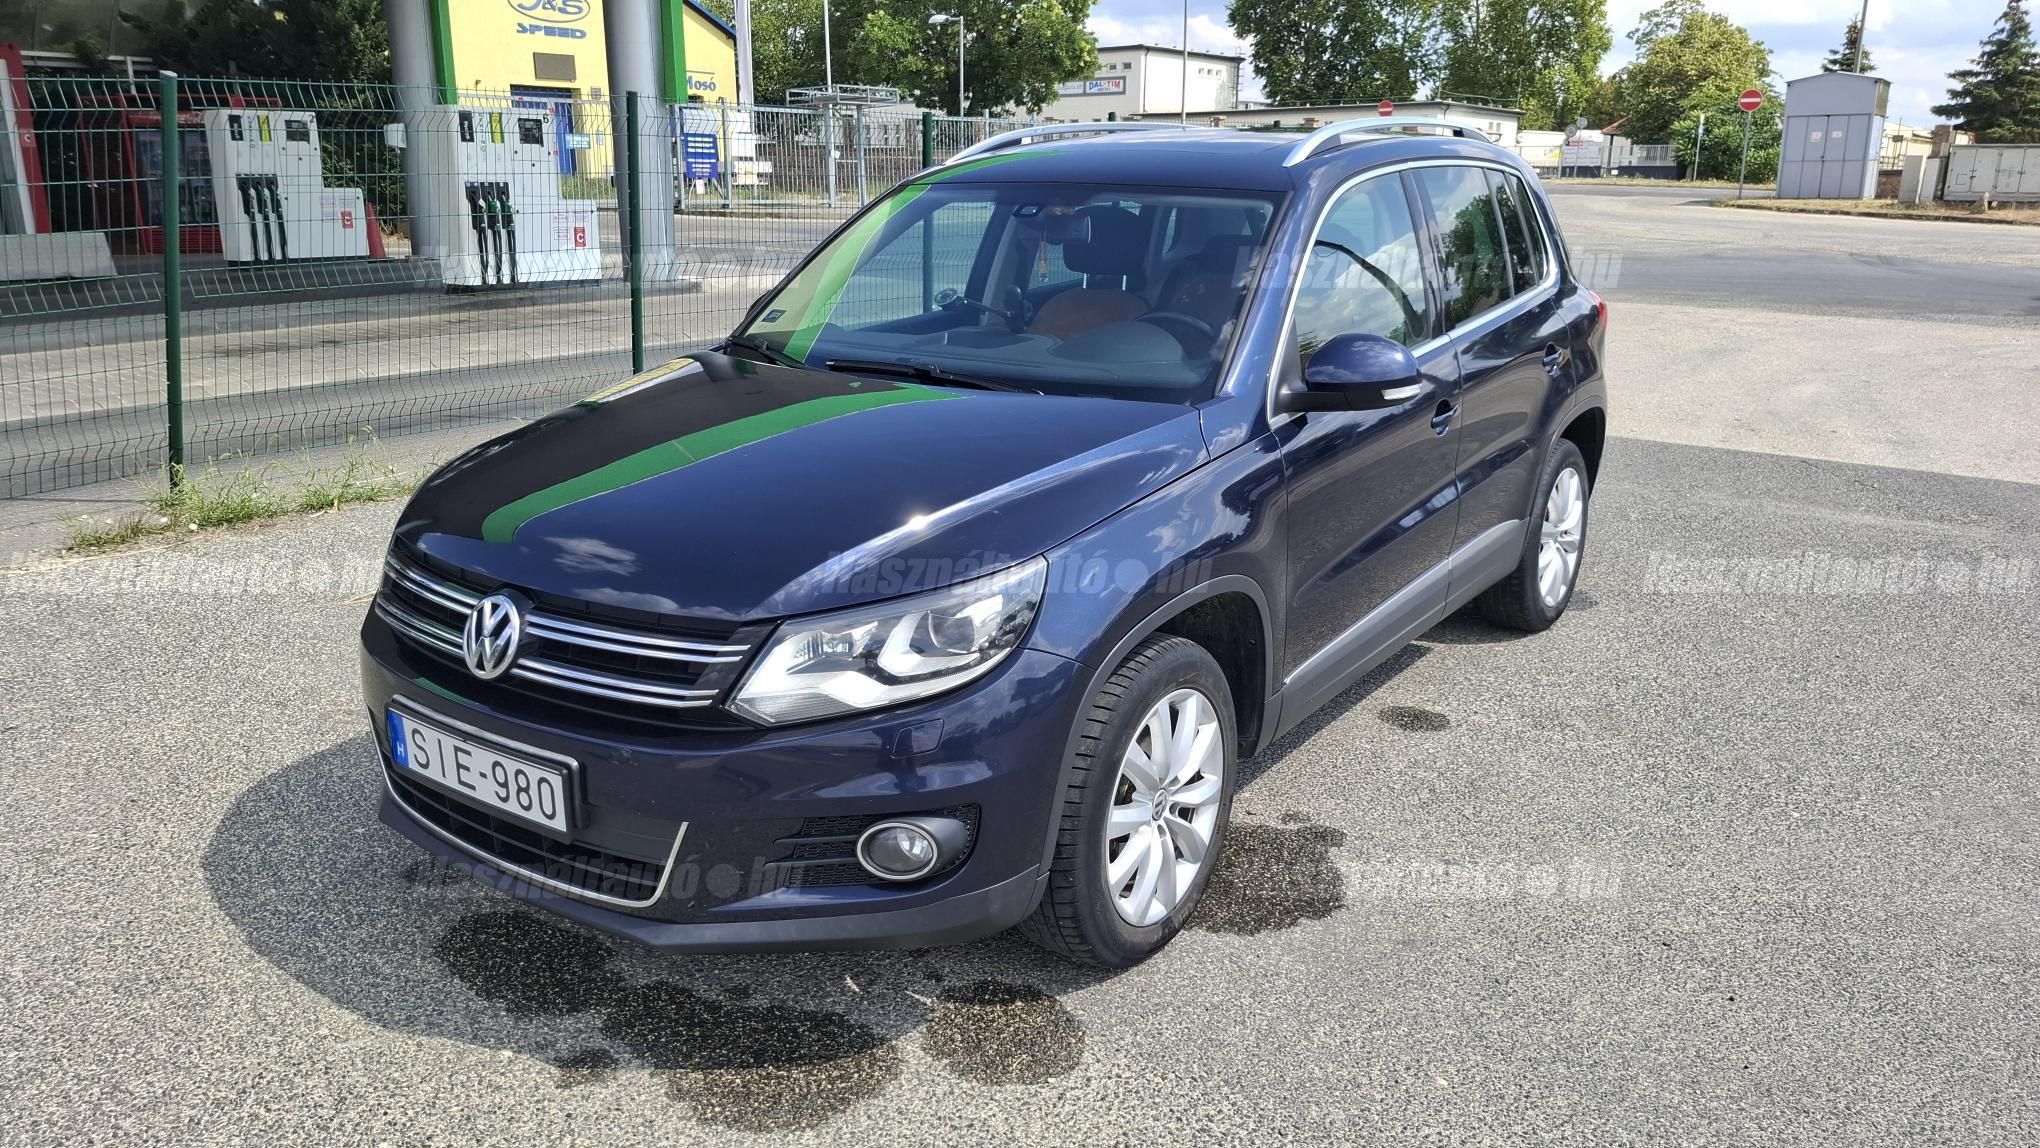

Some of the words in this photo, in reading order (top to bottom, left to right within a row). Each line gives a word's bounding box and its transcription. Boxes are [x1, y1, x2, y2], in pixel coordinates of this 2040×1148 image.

[516, 22, 587, 39] SPEED
[1088, 80, 1121, 90] DAL-TIM
[542, 113, 549, 123] 6
[344, 216, 351, 225] C
[576, 232, 584, 243] C
[396, 741, 405, 758] H
[411, 727, 557, 821] SIE-980
